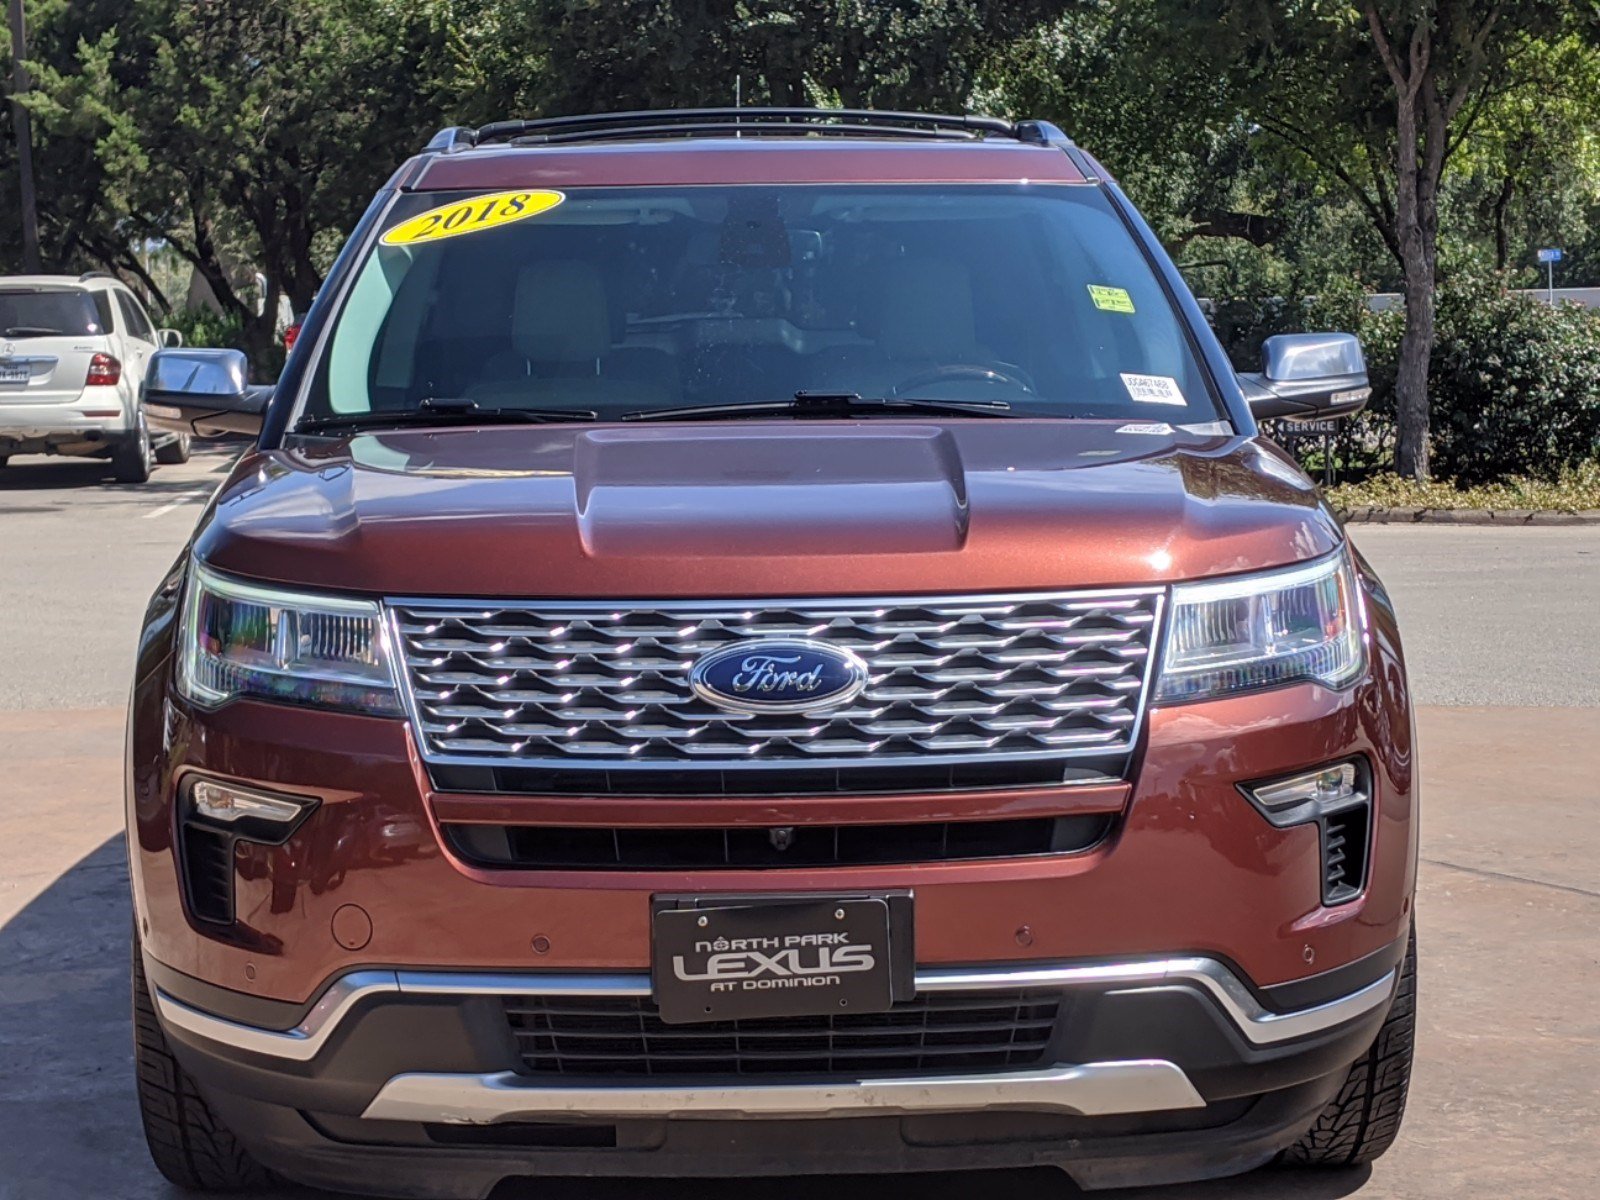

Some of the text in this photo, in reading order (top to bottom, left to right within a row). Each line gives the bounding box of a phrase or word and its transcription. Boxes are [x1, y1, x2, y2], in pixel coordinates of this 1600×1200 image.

[414, 193, 532, 238] 2018
[1286, 420, 1335, 432] SERVICE
[732, 655, 824, 692] Ford
[784, 932, 849, 948] PARK
[673, 945, 875, 981] LEXUS
[710, 975, 840, 992] AT DOMINION
